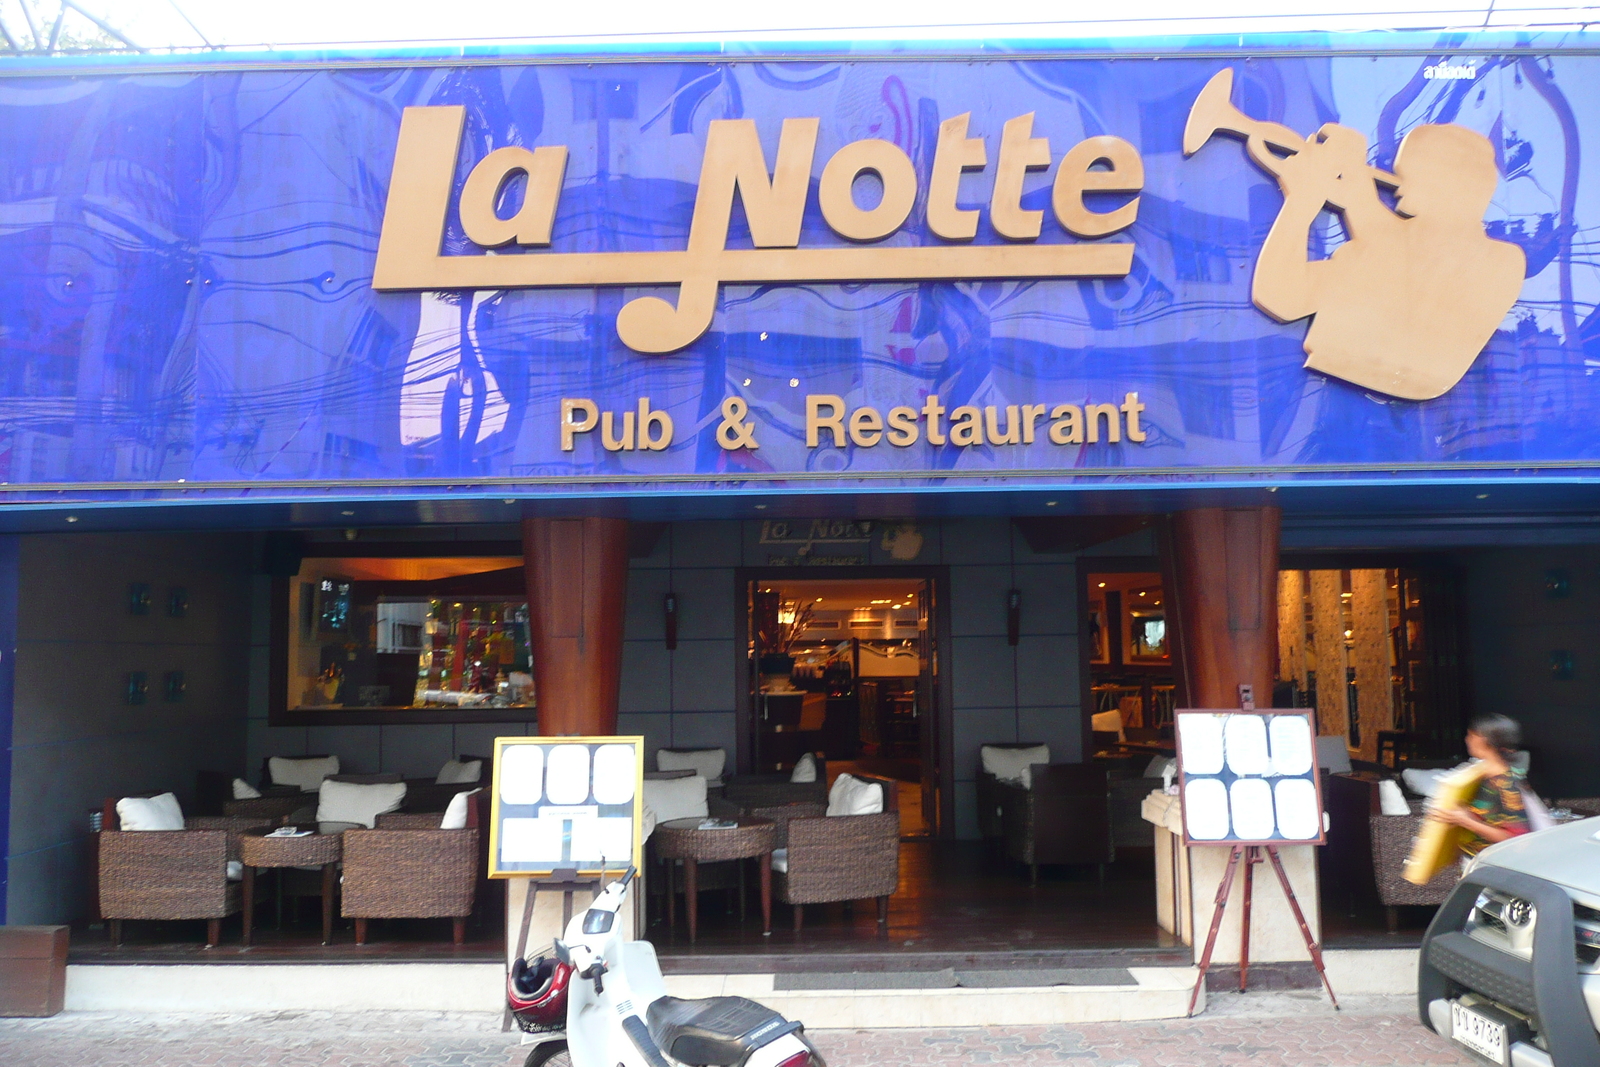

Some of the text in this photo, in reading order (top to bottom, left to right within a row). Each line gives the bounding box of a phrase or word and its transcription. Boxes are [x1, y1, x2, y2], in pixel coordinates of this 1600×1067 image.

[372, 104, 1146, 354] La Notte
[560, 391, 1147, 453] Pub & Restaurant
